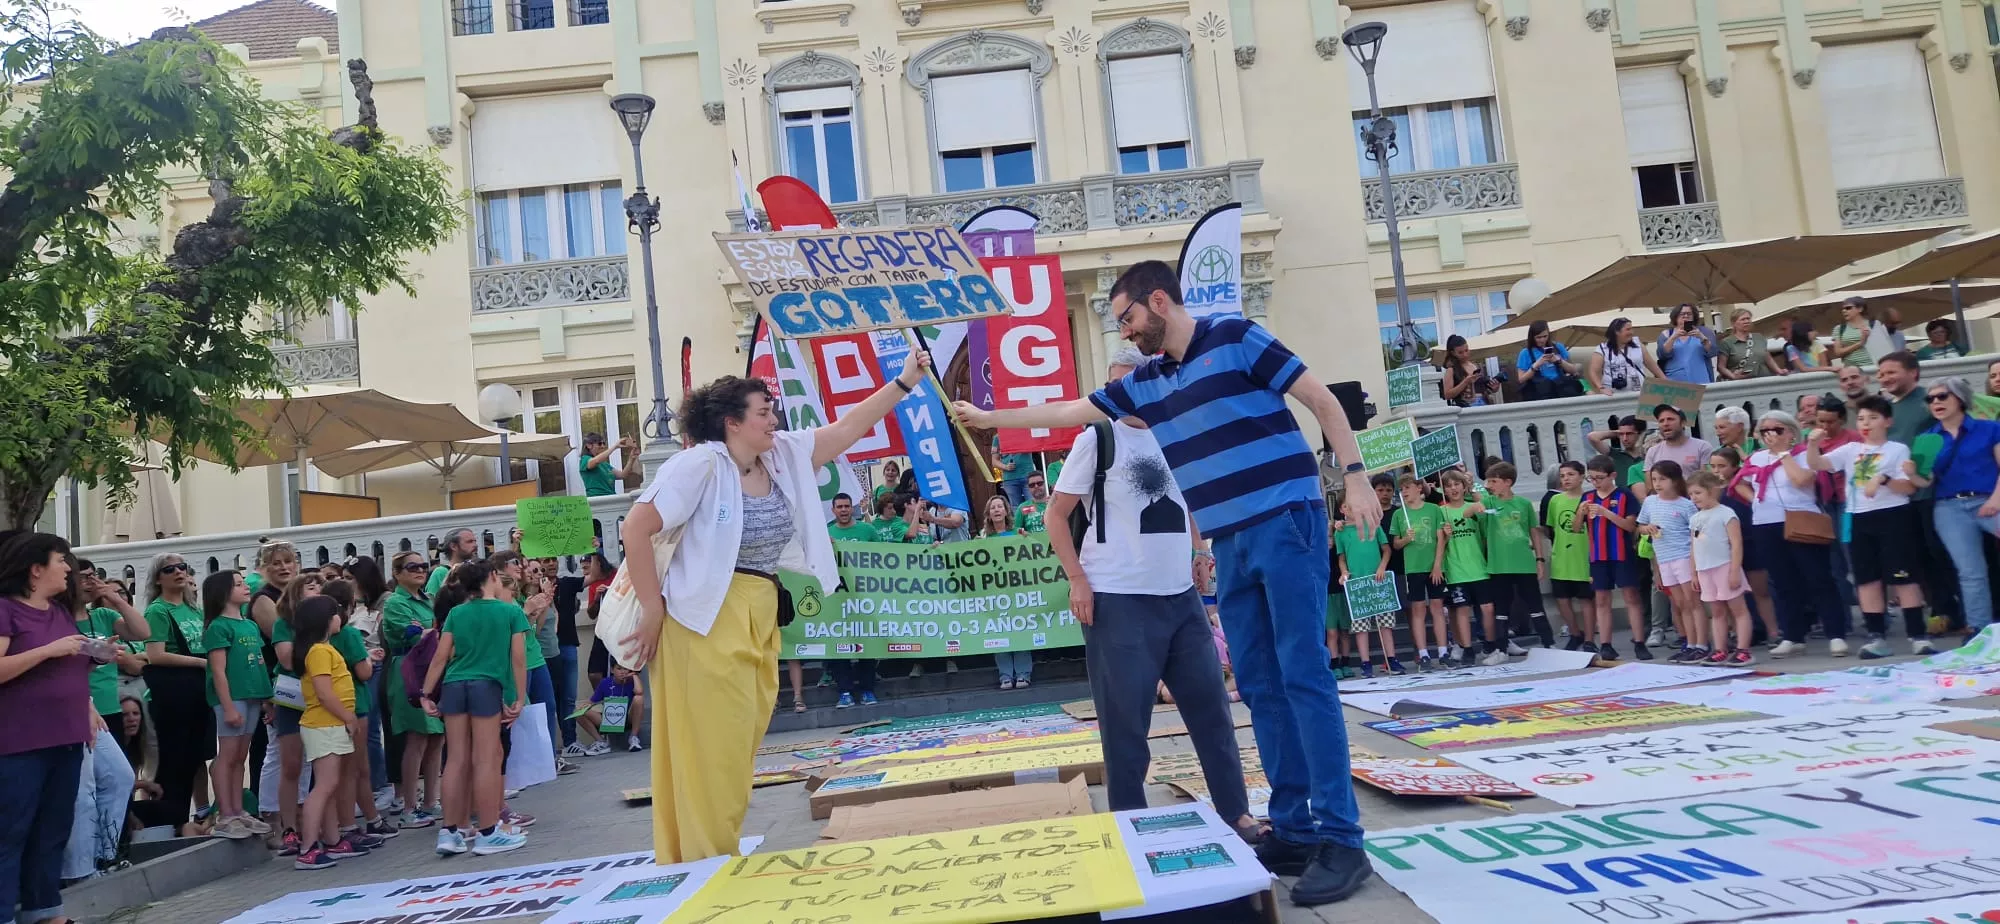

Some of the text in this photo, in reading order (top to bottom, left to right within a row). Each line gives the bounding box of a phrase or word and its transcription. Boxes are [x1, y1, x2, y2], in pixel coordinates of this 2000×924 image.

[797, 228, 974, 279] REGADERA
[750, 280, 773, 297] DE
[881, 269, 929, 283] TANTA
[1183, 281, 1237, 304] ANPE
[768, 274, 1007, 336] GOTERA
[836, 550, 900, 570] INERO
[906, 548, 998, 571] PÚBLICO,
[855, 571, 975, 594] EDUCACIÓN
[981, 563, 1070, 590] PÚBLICA
[841, 589, 1048, 619] ¡NO AL CONCIERTO DEL
[805, 619, 945, 639] BACHILLERATO,
[948, 620, 980, 637] 0-3
[983, 611, 1038, 634] AÑOS
[1040, 611, 1056, 628] Y
[1480, 708, 1950, 764] DINERO PÚBLICO
[1549, 743, 1752, 768] PARA
[1623, 736, 1968, 776] PÚBLICA
[1783, 787, 1924, 819] Y
[892, 838, 949, 855] A
[968, 825, 1078, 847] LOS
[384, 854, 656, 898] INVERSIÓ
[1488, 828, 1975, 895] VAN DE
[396, 878, 584, 908] MEJOR
[1567, 894, 1697, 923] POR
[1691, 887, 1797, 910] LA
